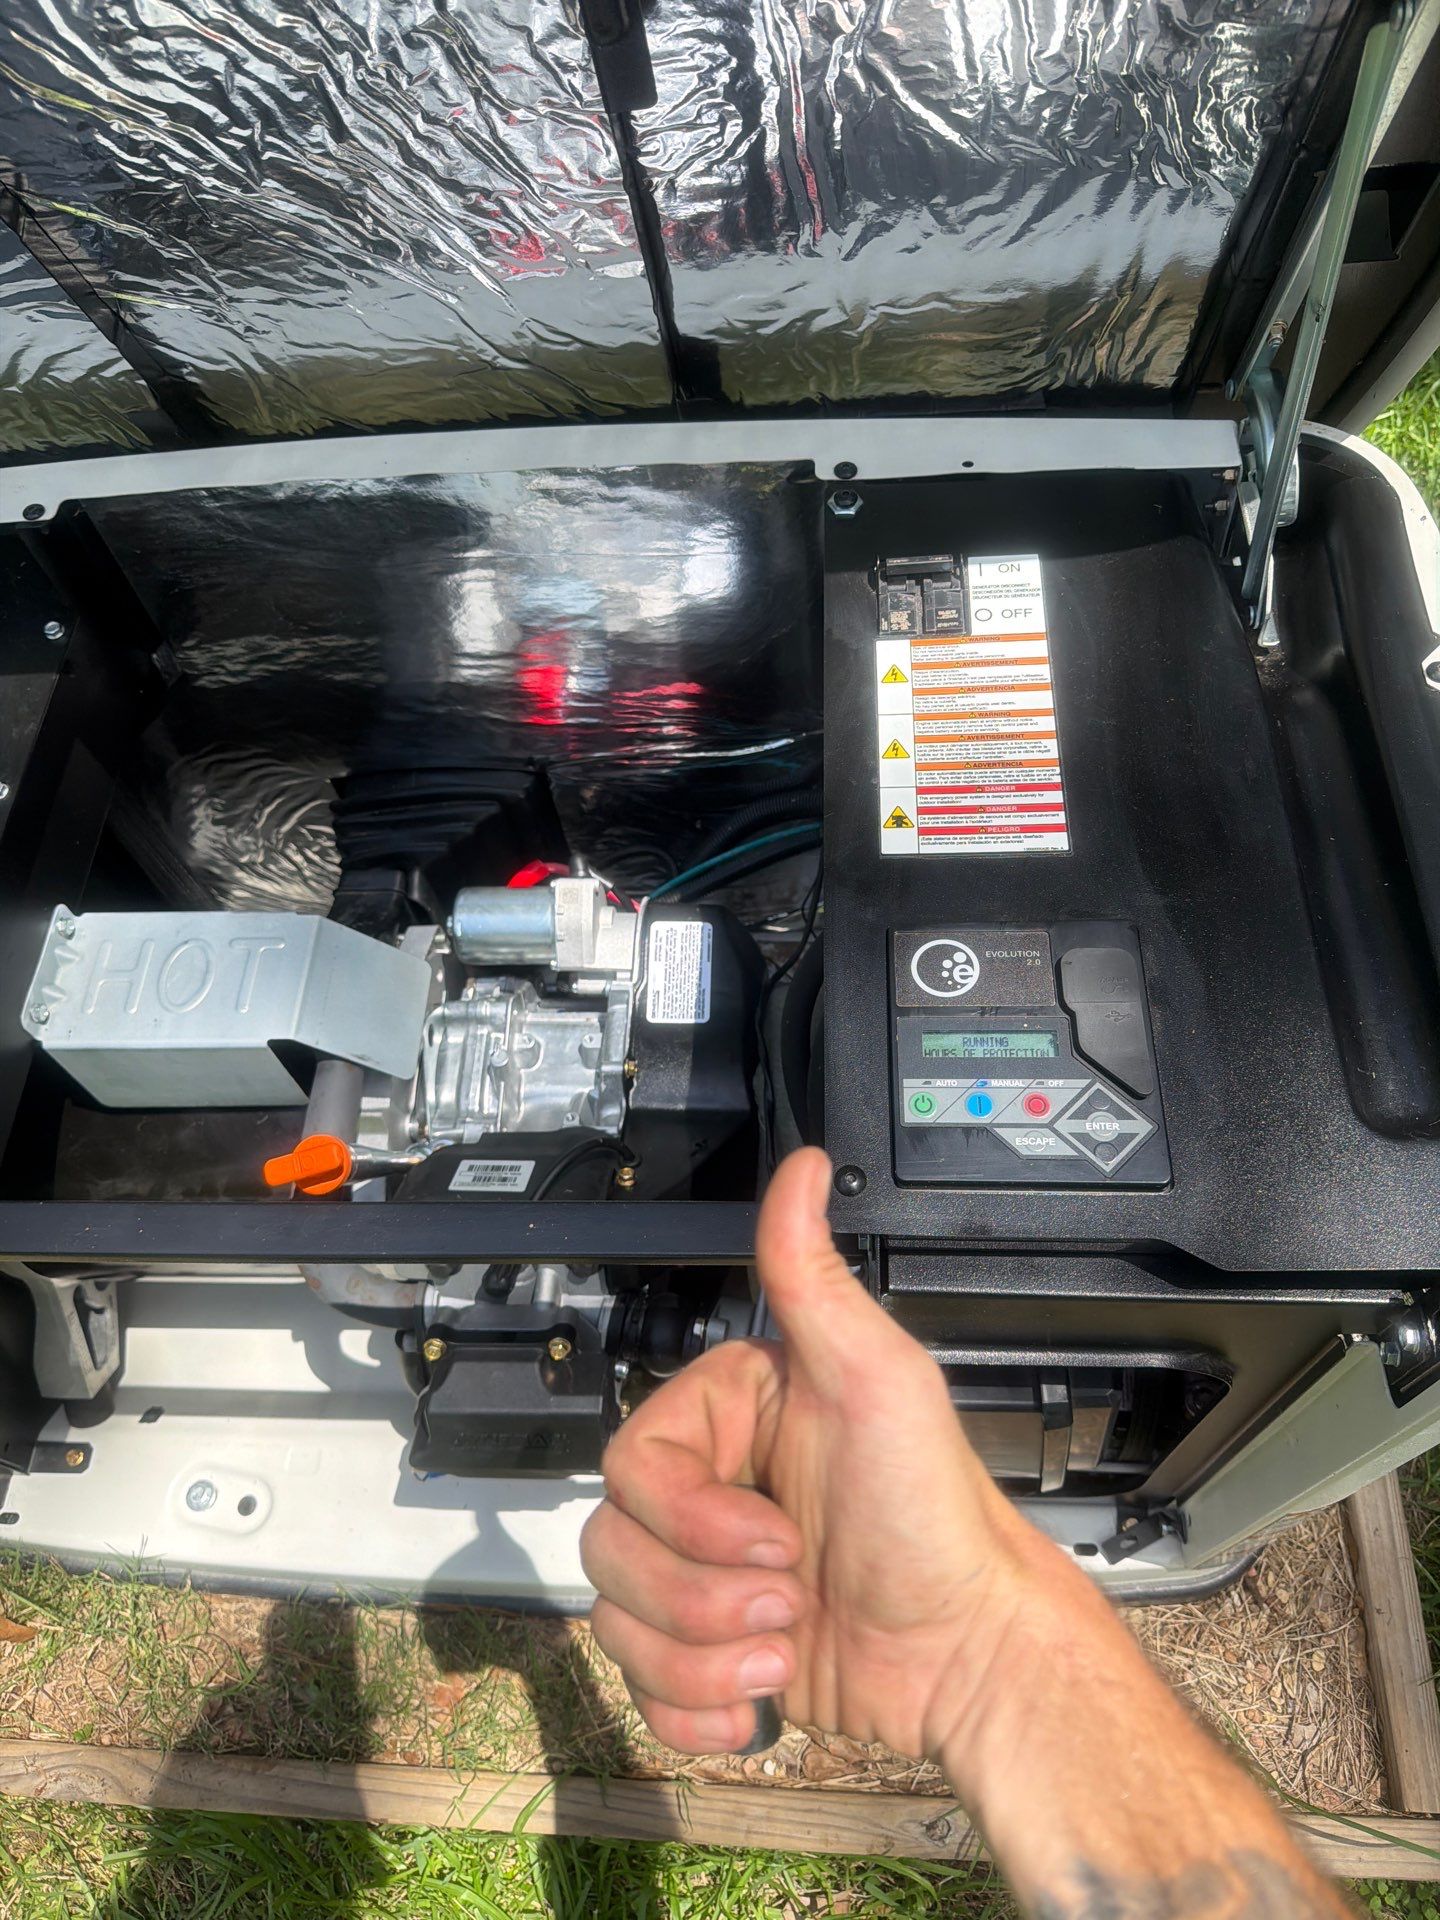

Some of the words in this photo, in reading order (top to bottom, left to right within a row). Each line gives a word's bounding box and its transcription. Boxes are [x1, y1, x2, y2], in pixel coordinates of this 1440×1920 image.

[998, 563, 1021, 573] ON
[1001, 608, 1033, 618] OFF
[962, 660, 1018, 668] AVERTISSEMENT
[967, 733, 1025, 741] AVERTISSEMENT
[986, 950, 1040, 958] EVOLUTION
[82, 938, 286, 1014] HOT
[962, 1036, 1009, 1048] RUNNING
[1085, 1122, 1120, 1131] ENTER
[1015, 1136, 1056, 1146] ESCAPE
